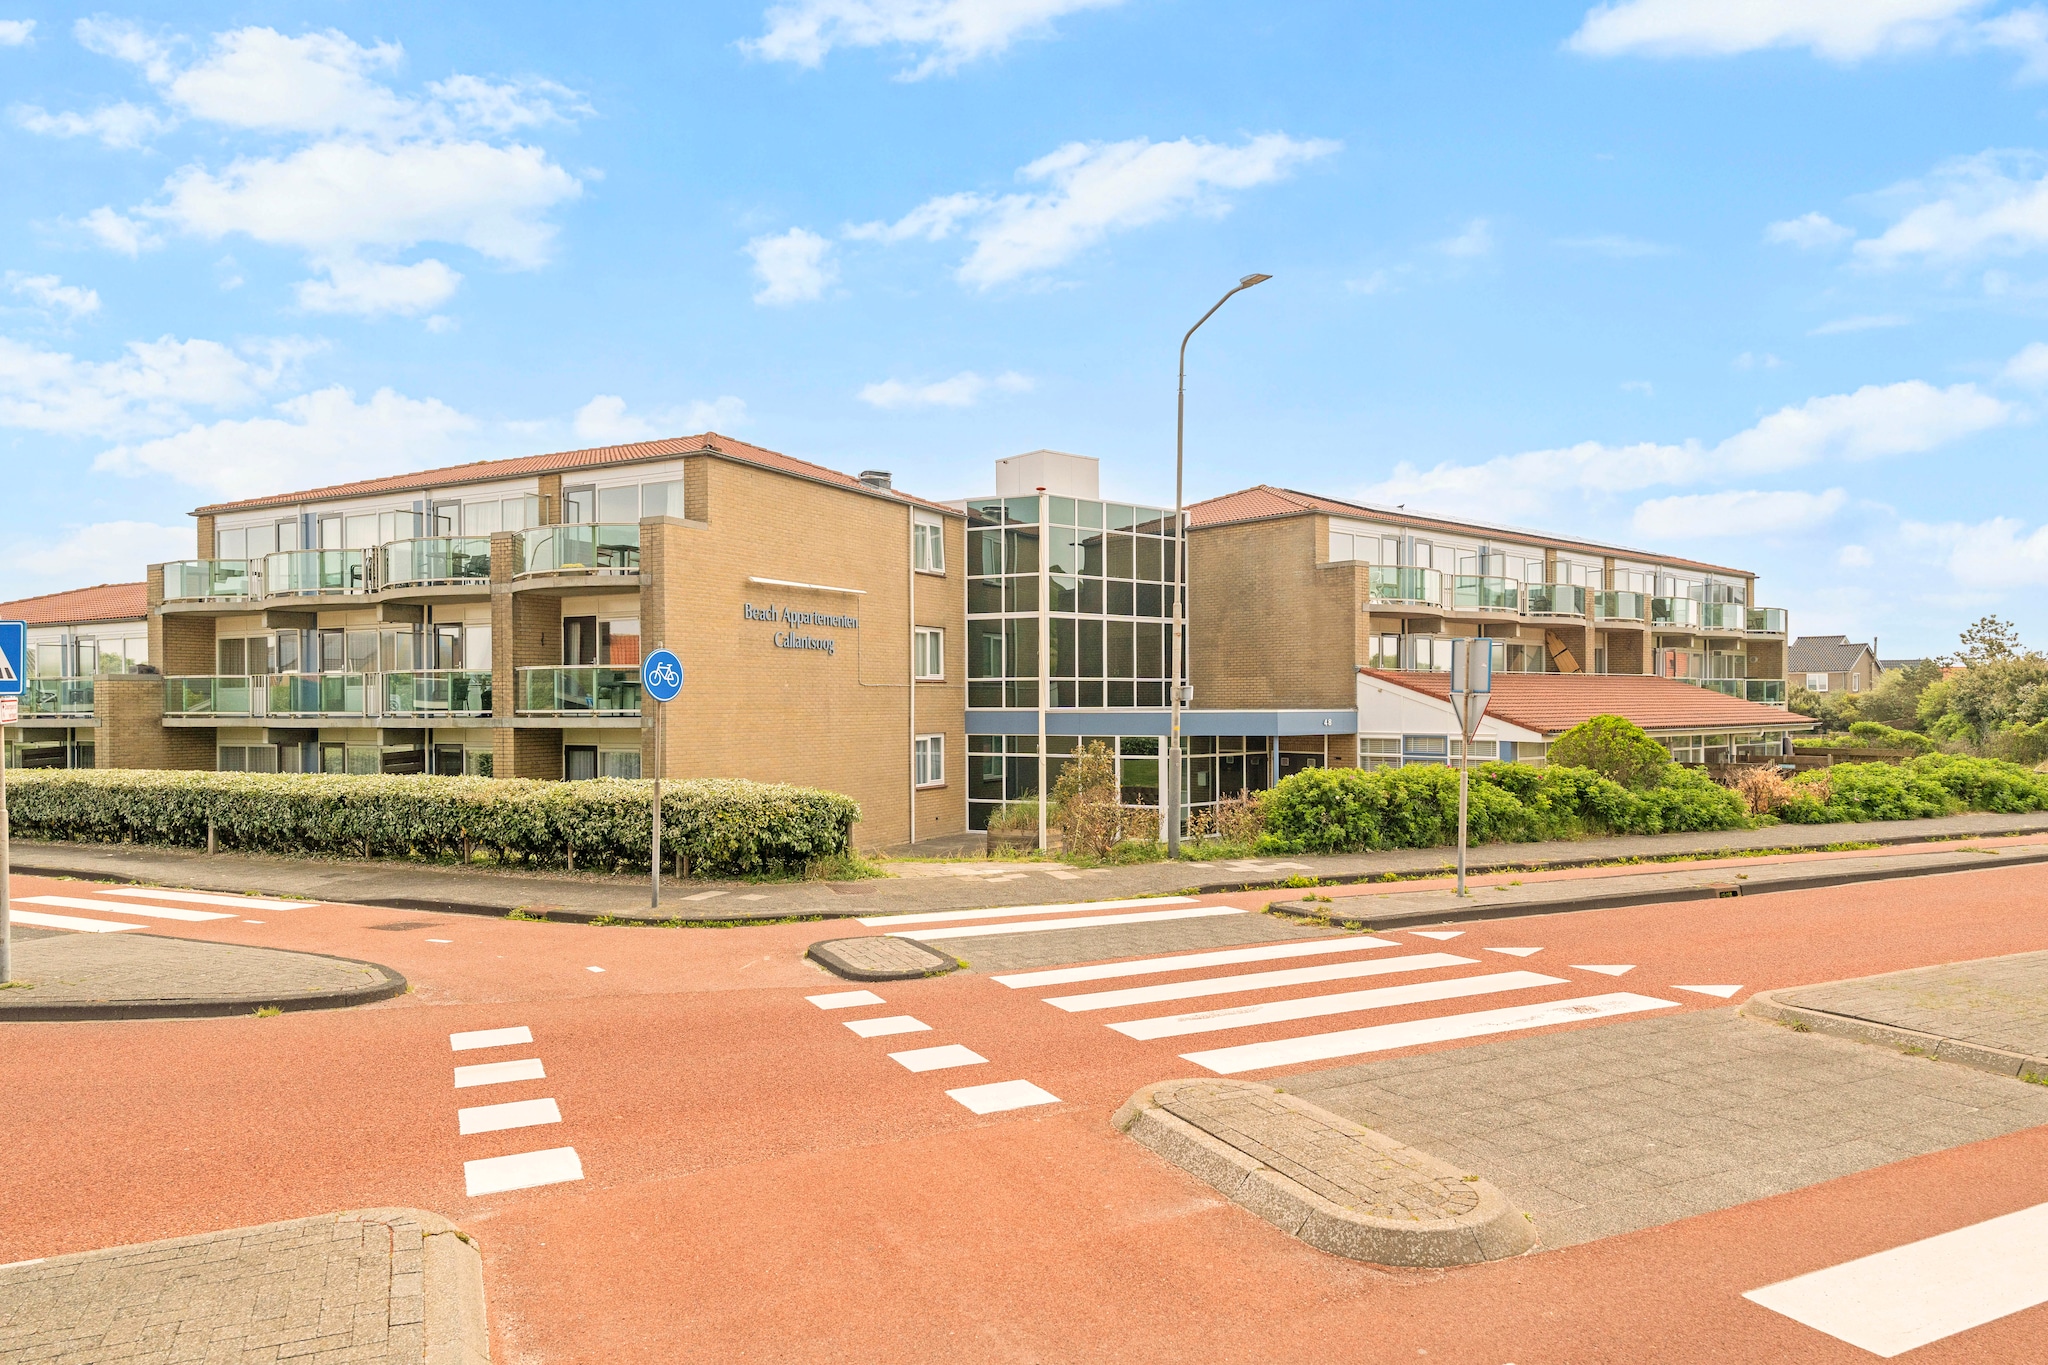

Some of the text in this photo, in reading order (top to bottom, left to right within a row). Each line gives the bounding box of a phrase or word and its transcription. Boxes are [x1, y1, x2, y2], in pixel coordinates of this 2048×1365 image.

[744, 602, 859, 628] Beach Appartementen
[774, 631, 835, 655] Callantsoog
[1323, 718, 1333, 727] 48
